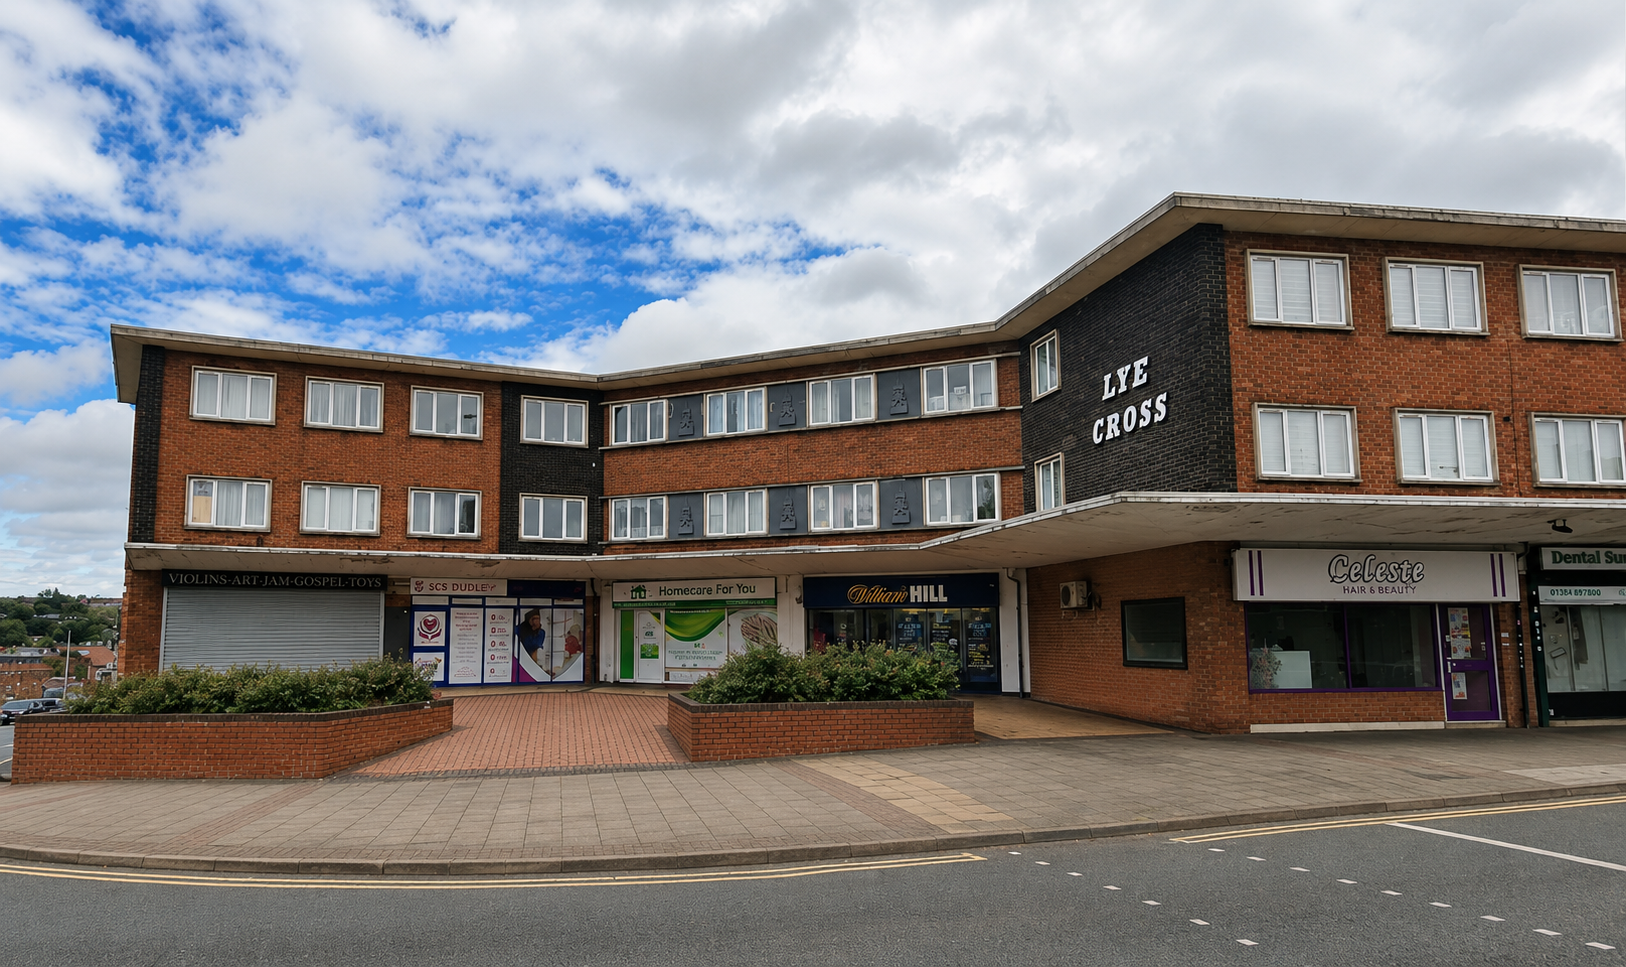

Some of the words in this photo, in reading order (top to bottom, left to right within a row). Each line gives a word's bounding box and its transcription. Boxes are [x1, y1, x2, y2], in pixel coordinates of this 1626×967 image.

[1101, 355, 1149, 401] LYE
[1092, 391, 1168, 445] CROSS
[1551, 550, 1601, 564] Dental
[1328, 553, 1425, 584] Celeste
[428, 582, 448, 591] SCS
[452, 583, 496, 592] DUDLEY
[659, 585, 713, 597] Homecare
[716, 583, 734, 595] For
[736, 583, 756, 594] You
[847, 583, 909, 604] William
[909, 584, 948, 603] HILL
[1343, 585, 1367, 594] HAIR
[1377, 585, 1416, 595] BEAUTY
